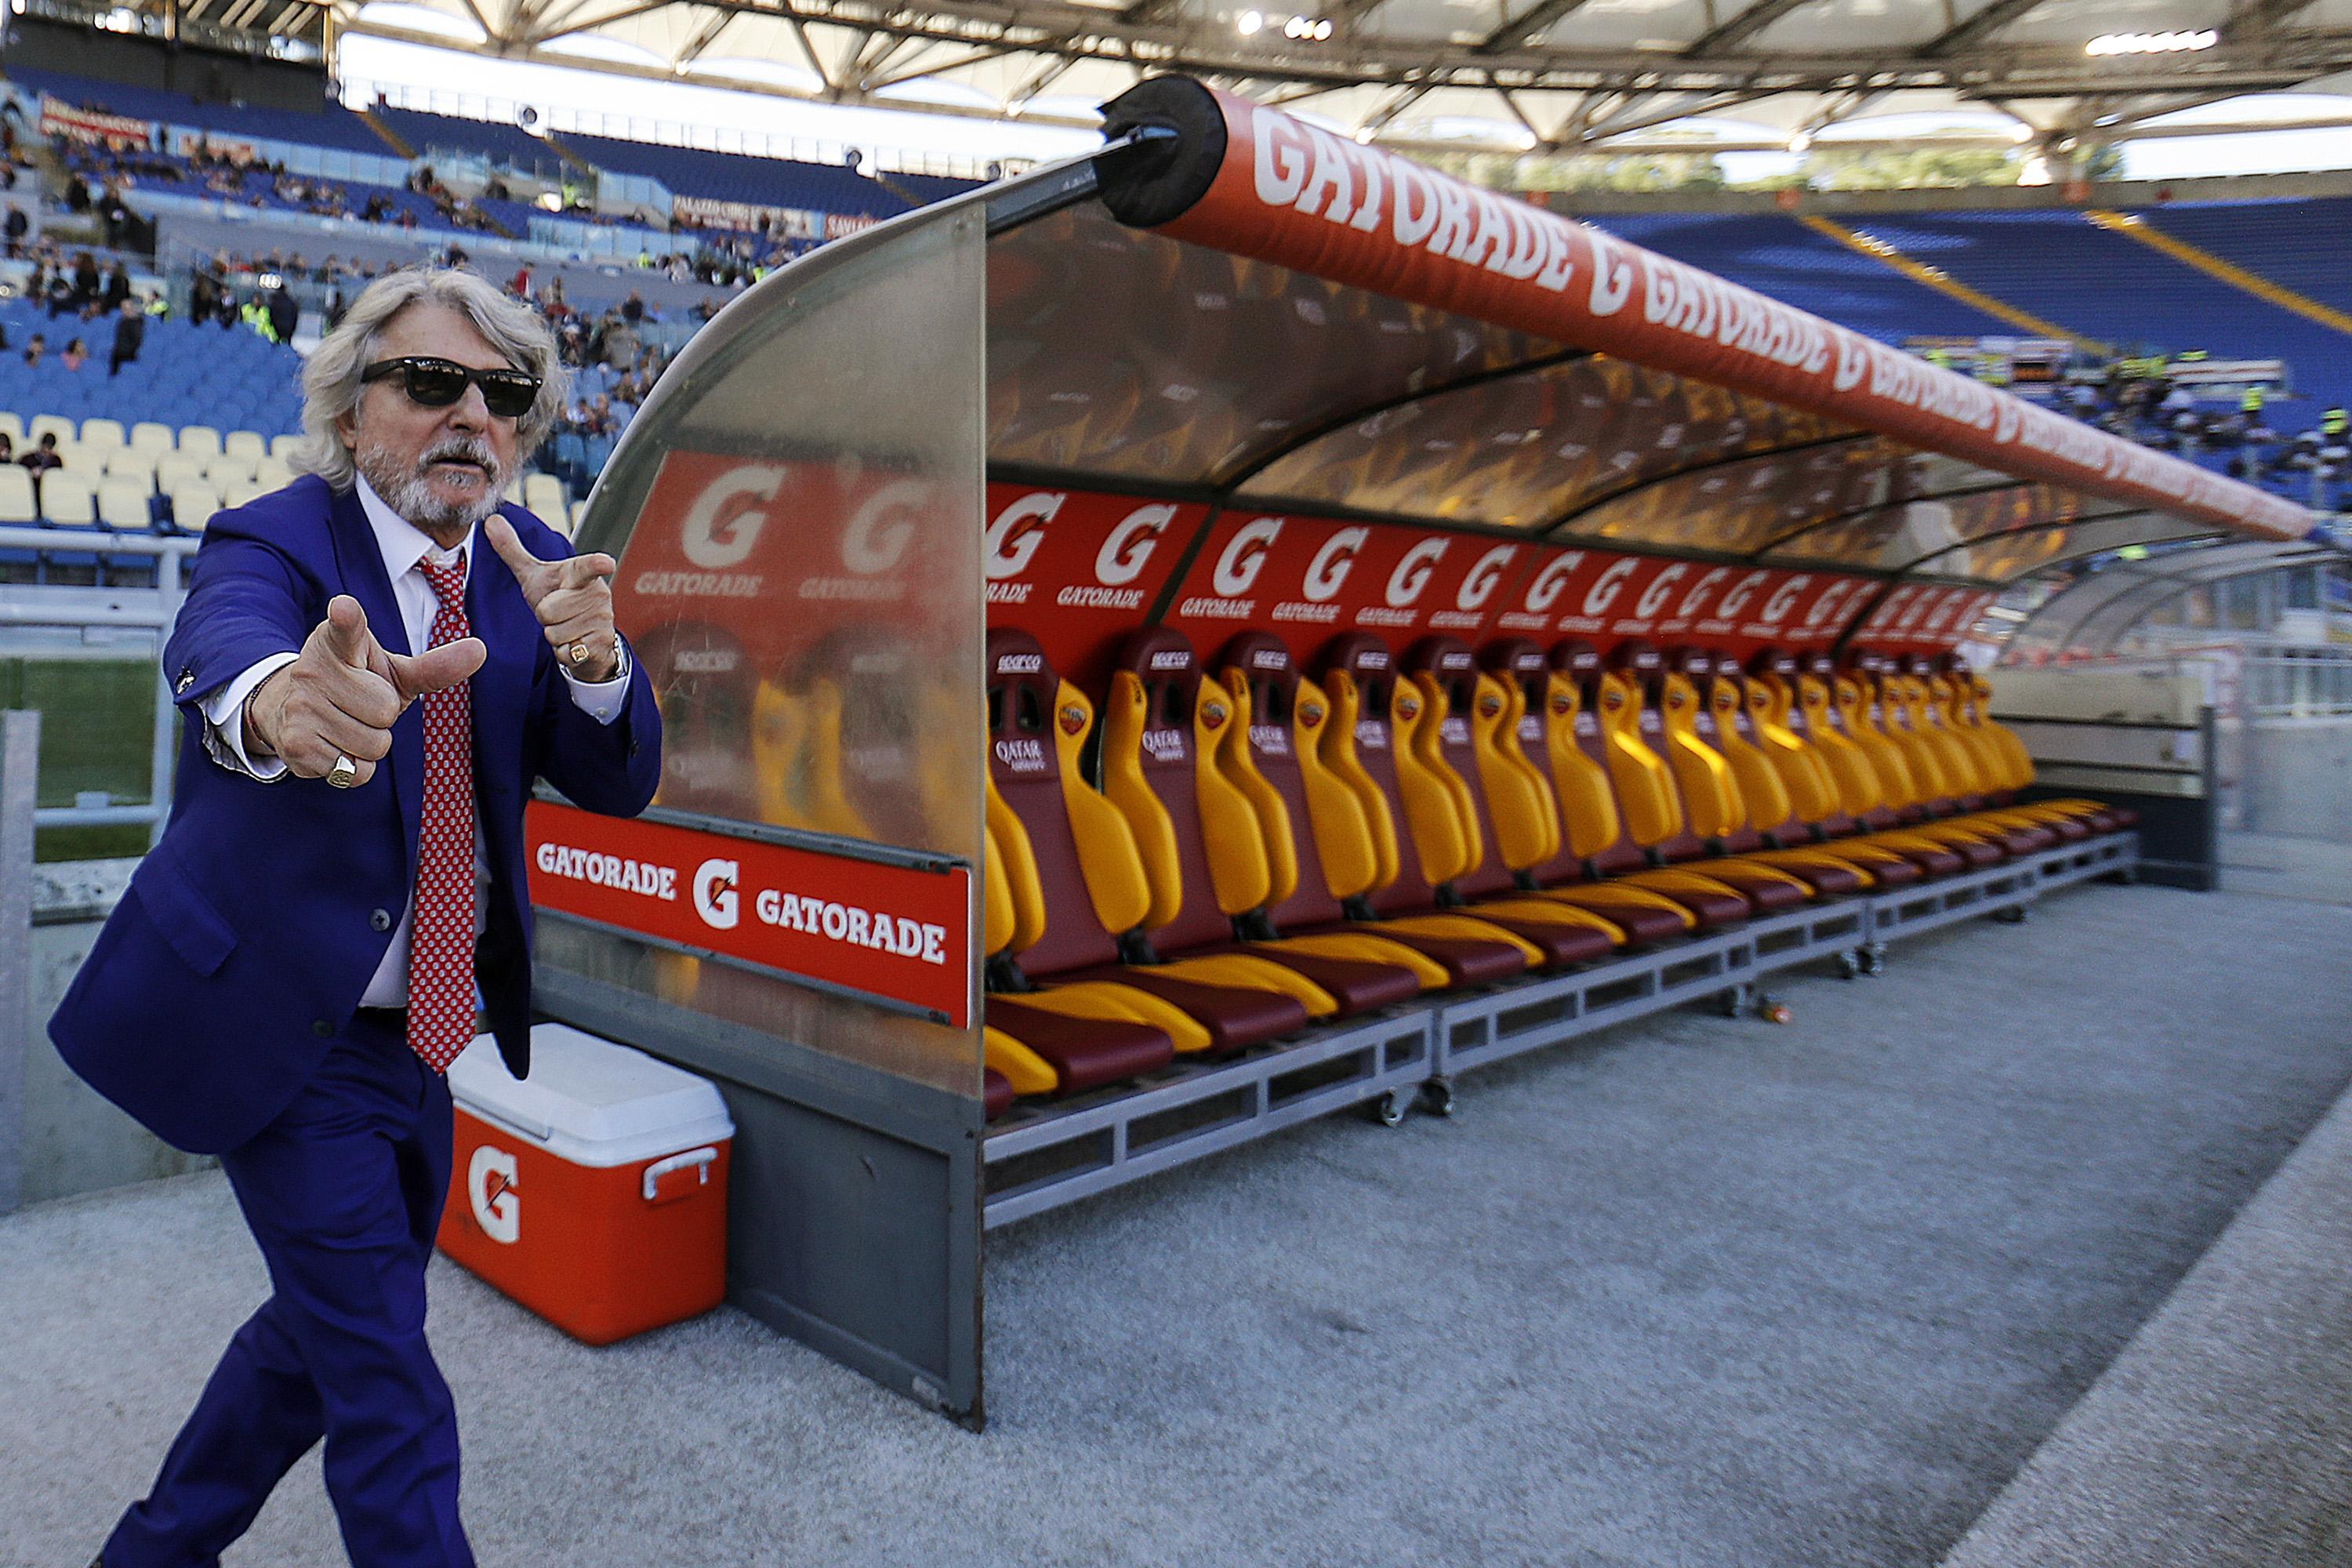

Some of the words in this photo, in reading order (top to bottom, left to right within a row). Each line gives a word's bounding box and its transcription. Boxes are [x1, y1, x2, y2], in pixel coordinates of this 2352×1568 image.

[1252, 105, 1573, 292] GATORADE
[681, 464, 787, 569] G
[985, 492, 1066, 579] G
[1095, 504, 1178, 586] G
[985, 583, 1033, 604] RADE
[1213, 517, 1286, 598] G
[1303, 526, 1370, 602] G
[1385, 536, 1450, 608] G
[1457, 544, 1518, 610] G
[1525, 550, 1586, 612] G
[1582, 557, 1640, 616] G
[1057, 586, 1144, 609] GATORADE
[1180, 597, 1255, 619] GATORADE
[996, 739, 1043, 764] QATAR
[535, 843, 677, 901] GATORADE
[692, 858, 739, 930] G
[756, 890, 946, 964] GATORADE
[468, 1145, 520, 1243] G
